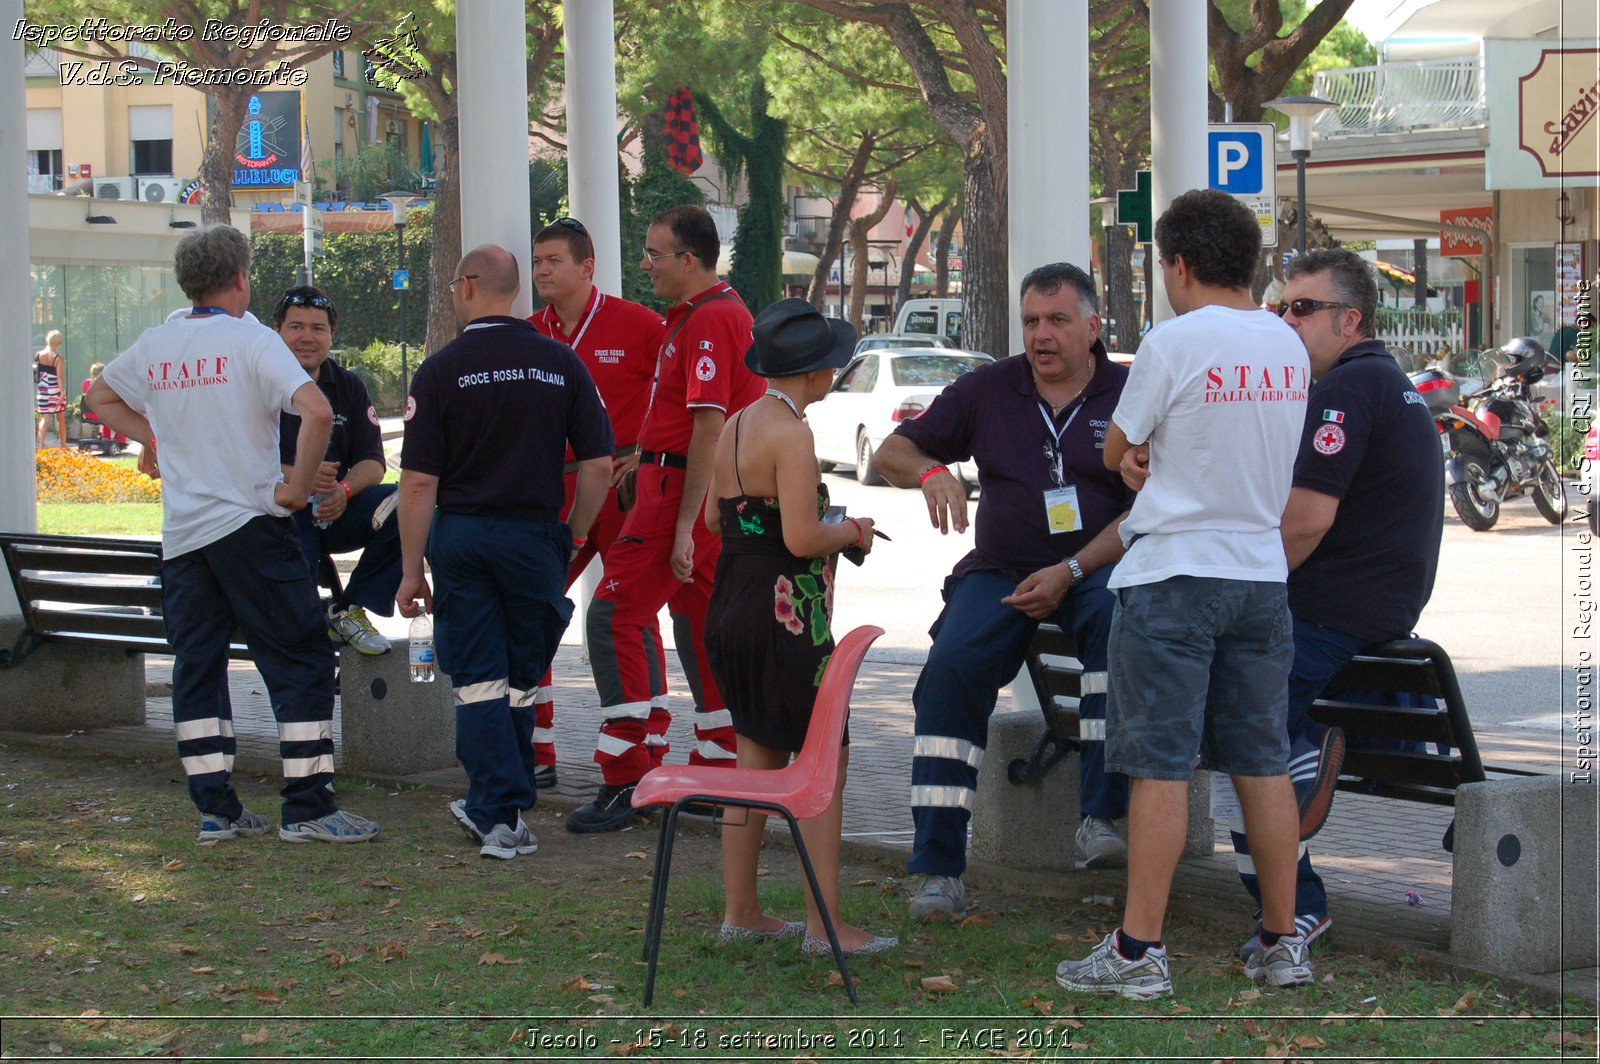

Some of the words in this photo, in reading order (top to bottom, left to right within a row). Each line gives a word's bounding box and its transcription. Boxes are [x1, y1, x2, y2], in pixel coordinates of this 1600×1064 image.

[235, 154, 277, 169] RISTORANTE
[1218, 141, 1249, 185] P
[911, 316, 935, 324] SERVIZI
[147, 356, 228, 382] STAFF
[198, 375, 228, 387] CROSS
[458, 372, 490, 388] CROCE
[493, 369, 525, 382] ROSSA
[528, 368, 565, 387] ITALIANA
